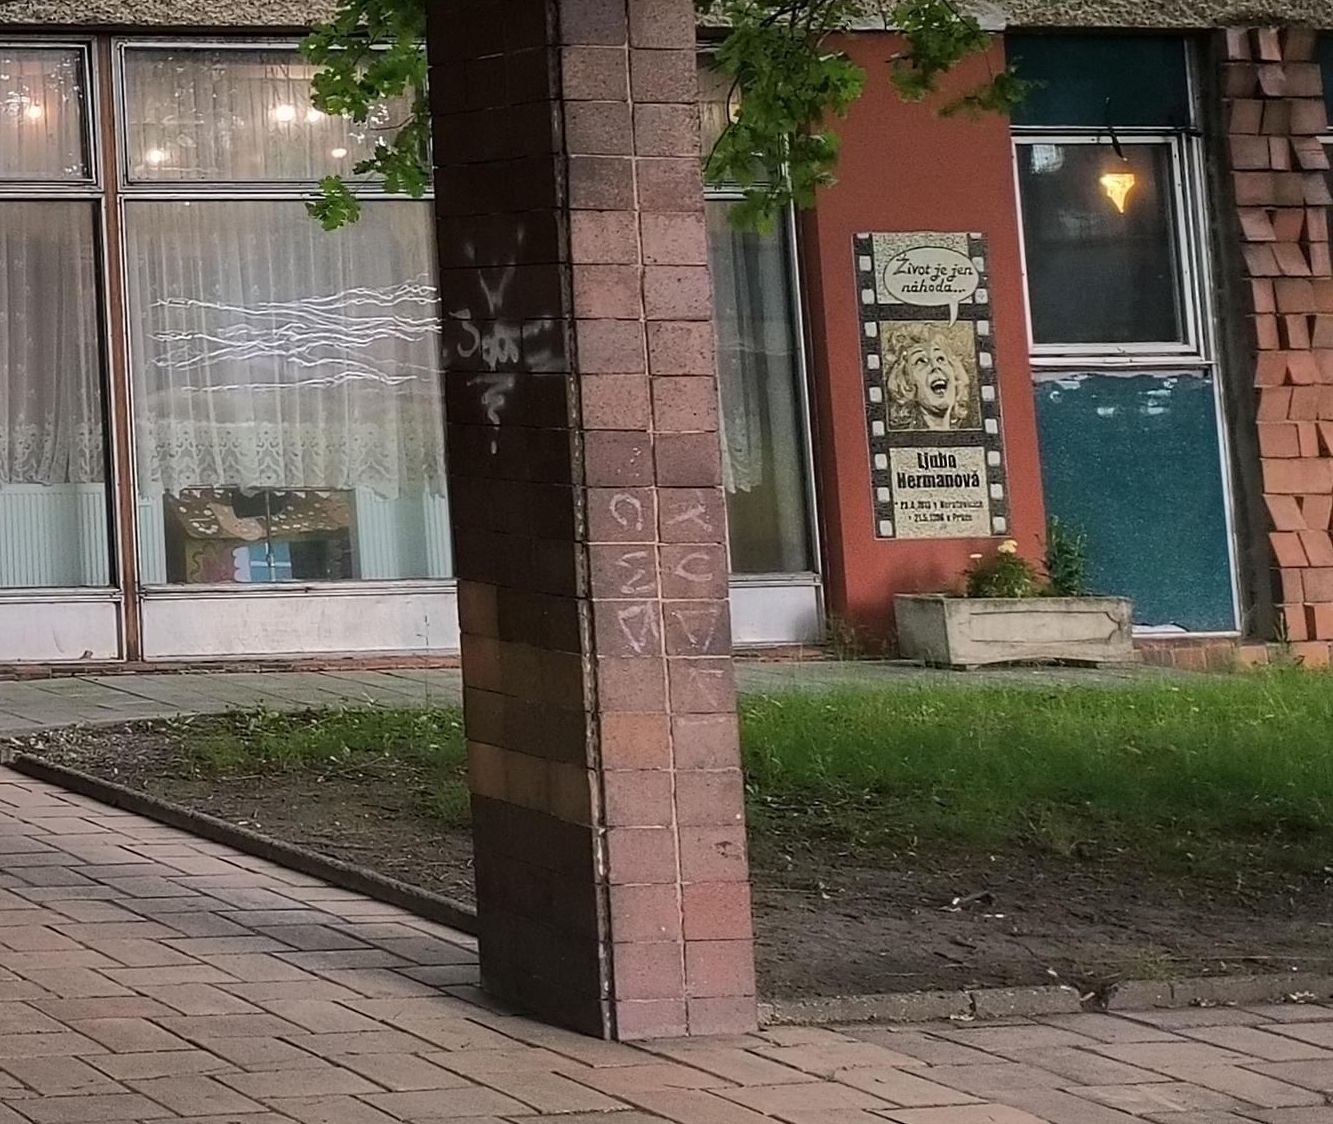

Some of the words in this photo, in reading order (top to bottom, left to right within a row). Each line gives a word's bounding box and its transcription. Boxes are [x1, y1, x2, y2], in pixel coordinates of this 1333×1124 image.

[893, 253, 932, 276] Život
[929, 263, 948, 282] je
[946, 263, 974, 283] jen
[901, 279, 966, 294] náhoda...
[916, 451, 957, 470] Ljuba
[896, 470, 980, 489] Hermanová
